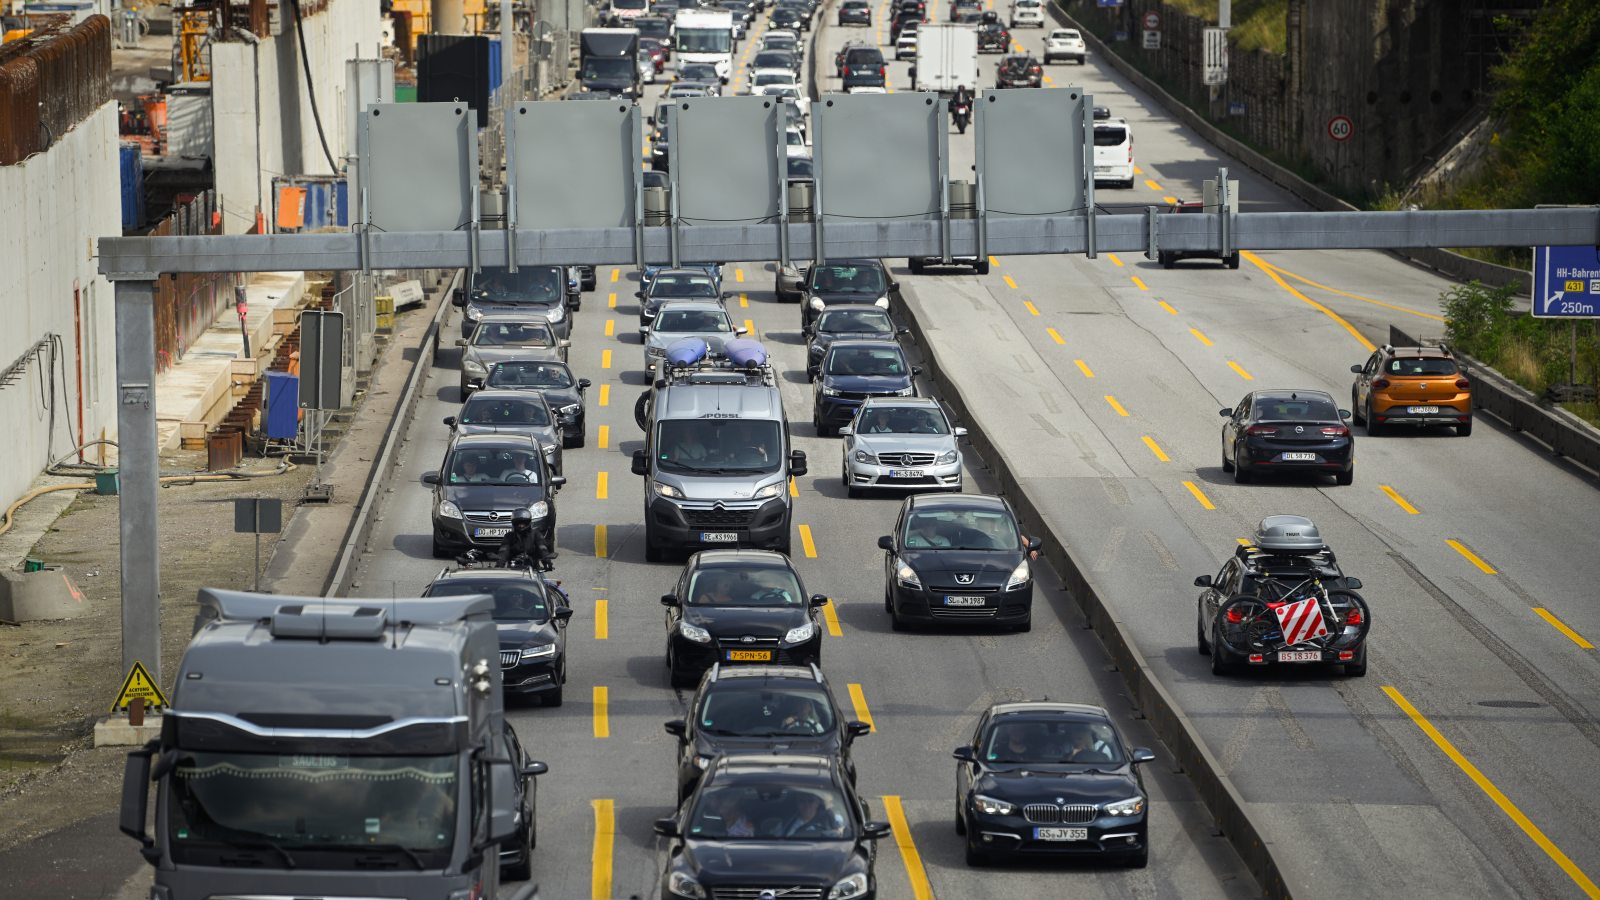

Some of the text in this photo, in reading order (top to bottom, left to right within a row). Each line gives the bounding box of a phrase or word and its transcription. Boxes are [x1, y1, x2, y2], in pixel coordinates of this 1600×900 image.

[1333, 122, 1348, 135] 60
[1567, 282, 1581, 291] 431
[1561, 302, 1593, 313] 250m
[732, 652, 767, 660] 7-SPN-56
[1294, 652, 1303, 660] 18
[1304, 652, 1318, 660] 376
[1039, 829, 1051, 838] GS
[1069, 829, 1086, 838] 355
